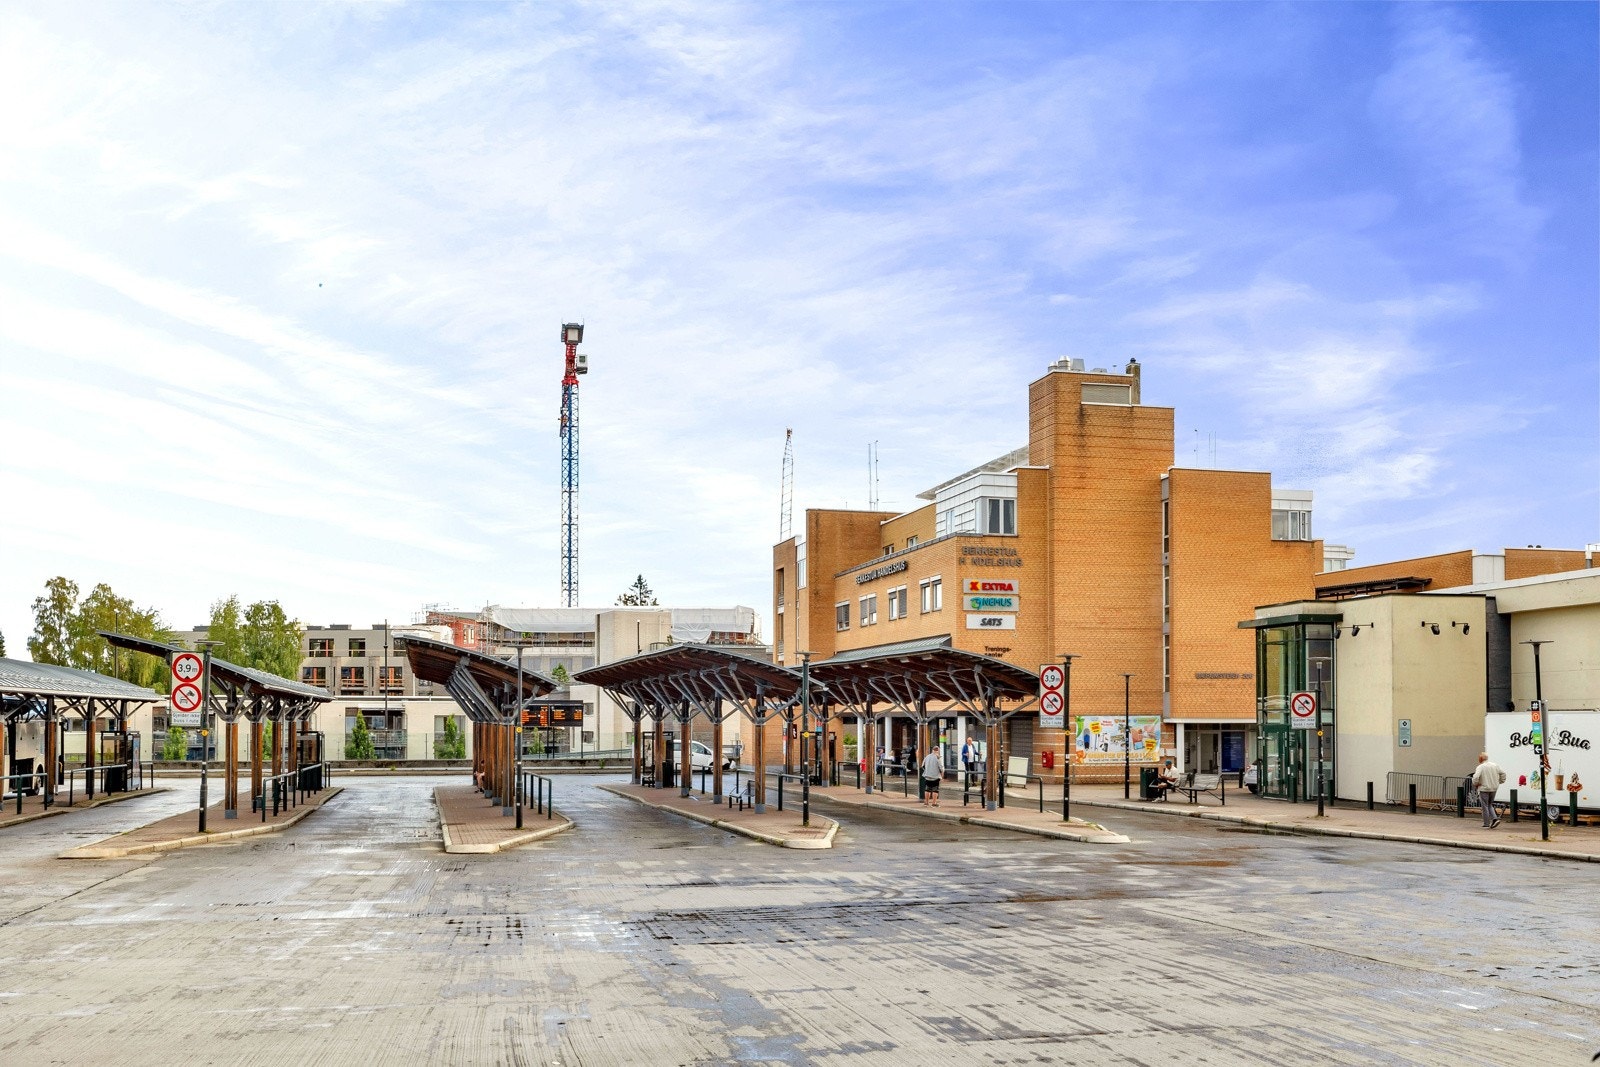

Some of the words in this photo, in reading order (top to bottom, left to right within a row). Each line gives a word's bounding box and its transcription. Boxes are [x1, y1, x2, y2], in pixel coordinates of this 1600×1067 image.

[981, 582, 1013, 591] EXTRA
[982, 597, 1012, 607] NEMUS
[980, 617, 1003, 626] SATS
[178, 663, 192, 673] 3,9
[1044, 674, 1056, 682] 3,9
[1559, 730, 1591, 750] Bua
